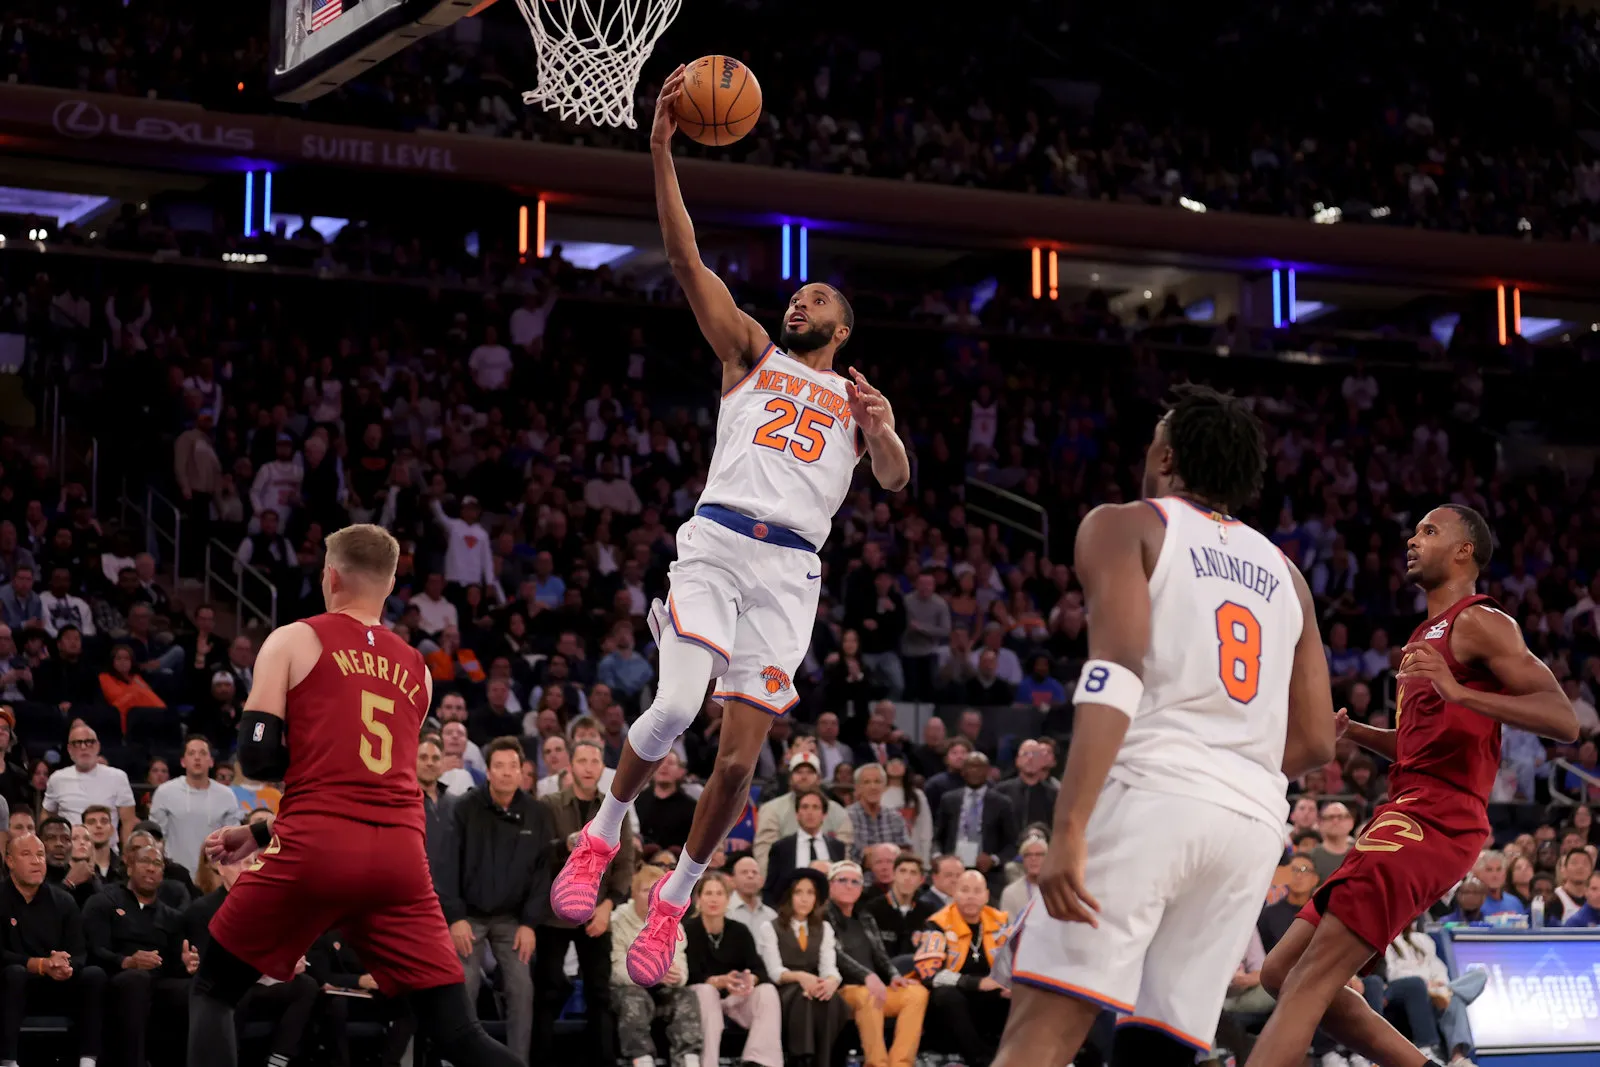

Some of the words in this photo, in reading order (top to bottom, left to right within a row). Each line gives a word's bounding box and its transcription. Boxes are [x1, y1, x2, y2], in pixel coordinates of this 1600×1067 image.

[109, 113, 254, 150] LEXUS
[302, 134, 374, 165] SUITE
[382, 142, 457, 172] LEVEL
[754, 369, 808, 397] NEW
[806, 381, 852, 430] YORK
[752, 397, 835, 464] 25
[1189, 546, 1280, 603] ANUNOBY
[332, 649, 421, 705] MERRILL
[1084, 666, 1110, 694] 8
[1215, 600, 1262, 705] 8
[359, 689, 395, 775] 5
[1492, 963, 1598, 1030] League
